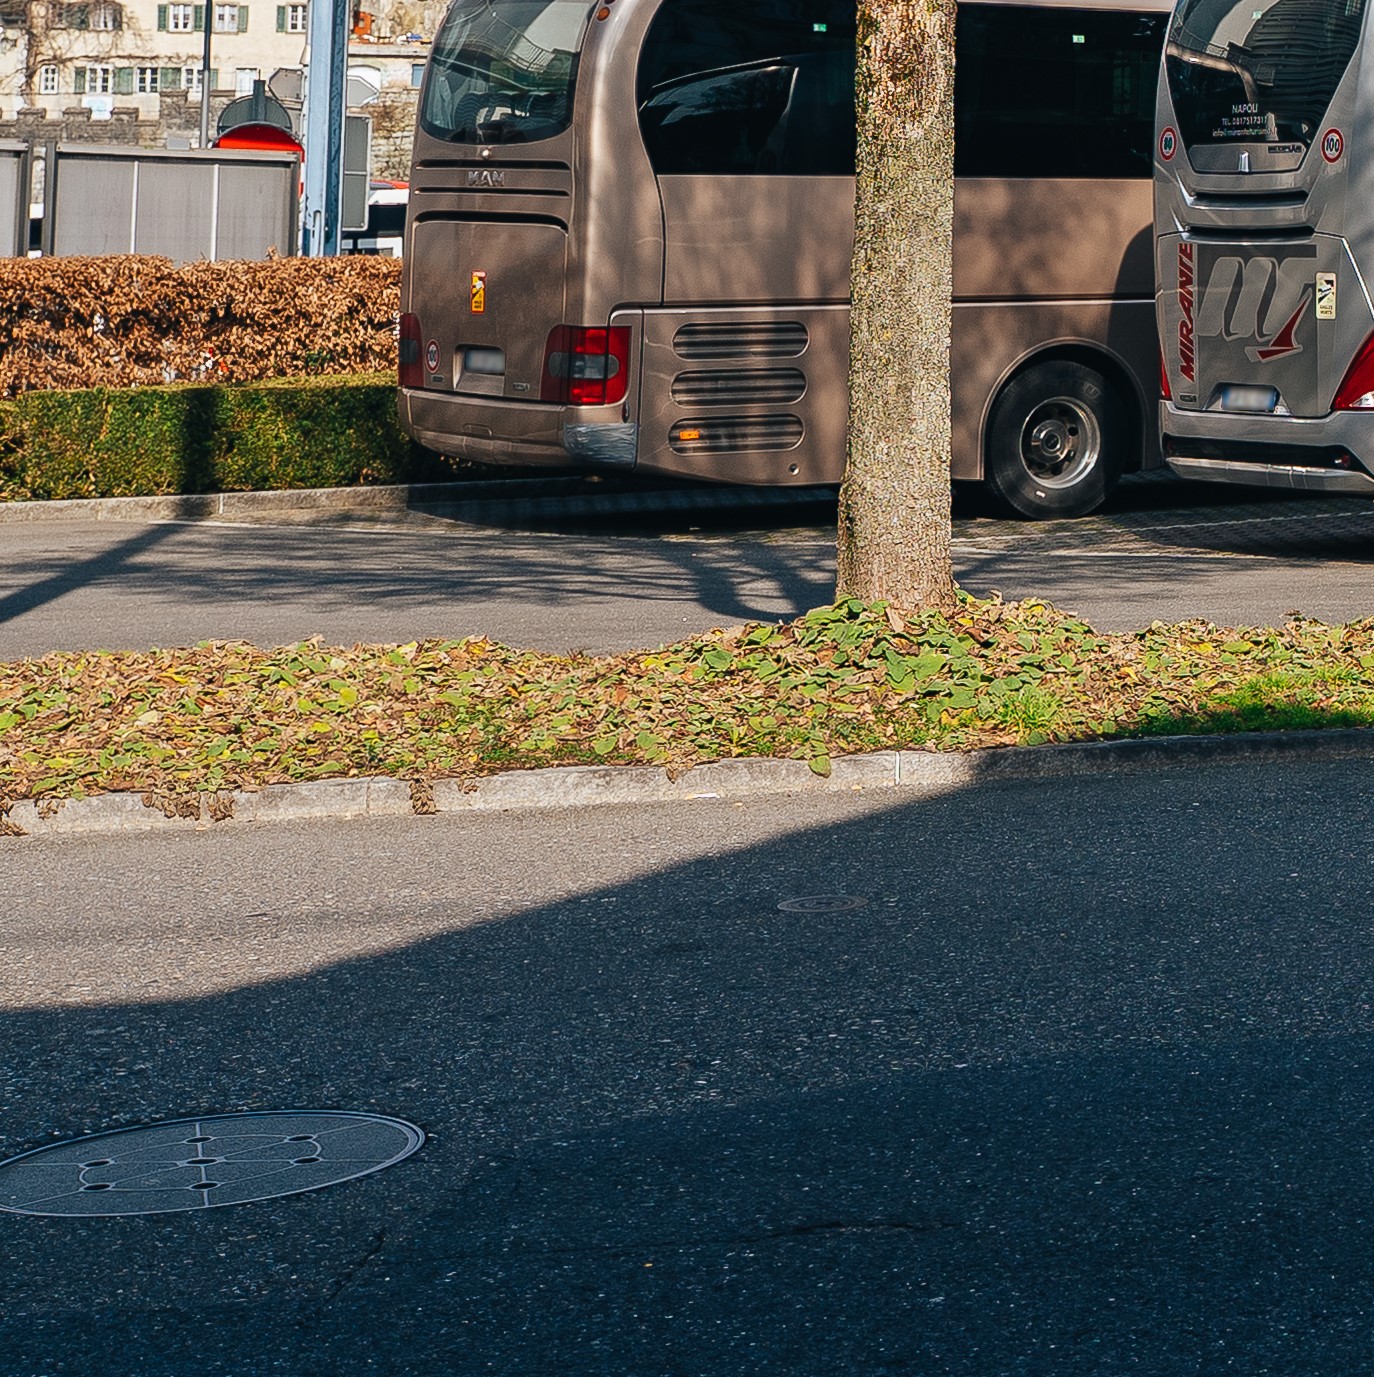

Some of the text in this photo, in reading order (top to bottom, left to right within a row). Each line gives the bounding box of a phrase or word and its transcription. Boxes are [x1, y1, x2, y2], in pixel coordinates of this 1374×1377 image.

[1231, 102, 1259, 114] NAPOLI
[1326, 137, 1341, 153] 100
[1177, 242, 1196, 383] MIRANTE
